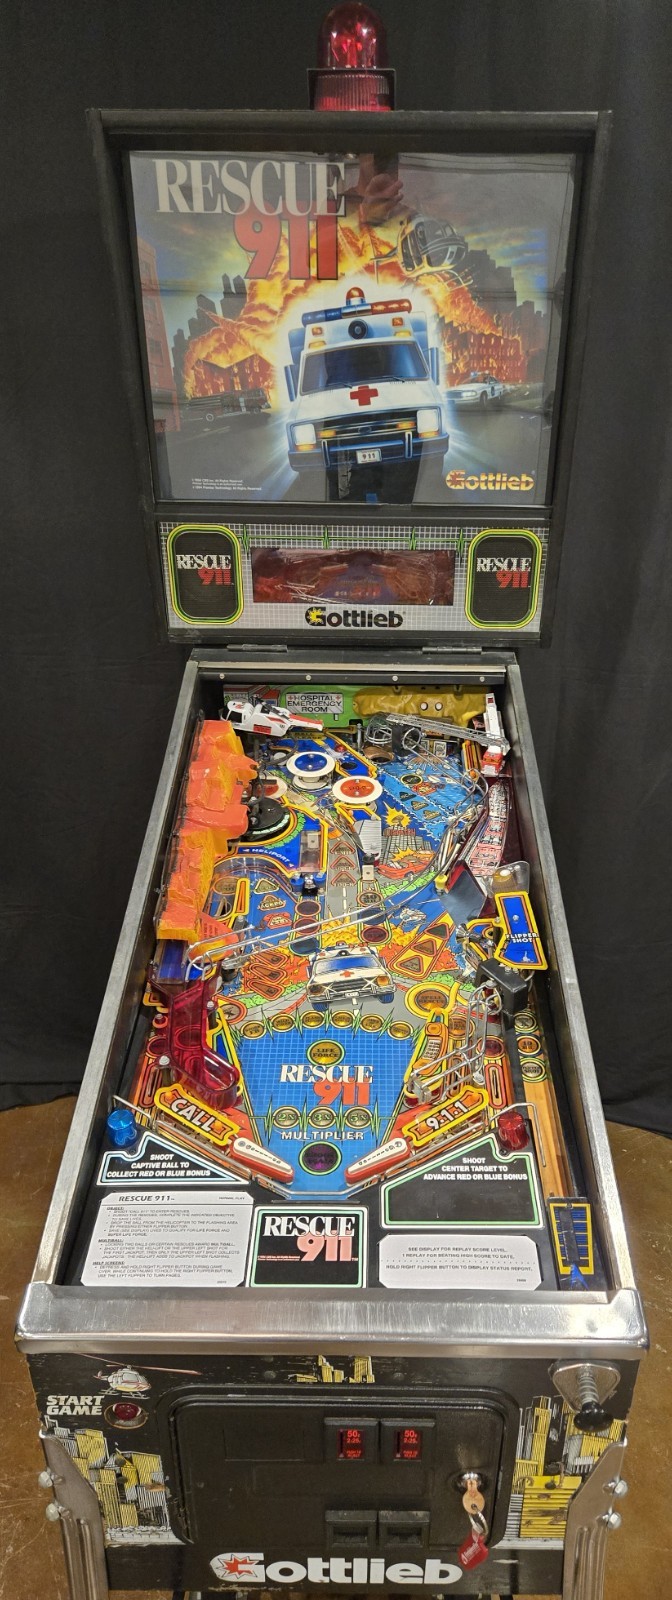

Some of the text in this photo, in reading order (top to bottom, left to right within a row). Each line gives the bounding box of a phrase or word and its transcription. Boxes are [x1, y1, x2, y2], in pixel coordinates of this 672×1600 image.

[152, 159, 346, 217] RESCUE
[233, 205, 338, 280] 911
[445, 469, 534, 491] Gottlieb
[175, 554, 232, 570] RESCUE
[476, 557, 532, 572] RESCUE
[197, 568, 231, 586] 911
[496, 570, 529, 588] 911
[305, 606, 403, 628] Gottlieb
[252, 848, 290, 862] HELIPORT
[279, 1064, 374, 1084] RESCUE
[313, 1080, 370, 1106] 911
[170, 1098, 216, 1132] CALL
[281, 1131, 364, 1140] MULTIPLIER
[106, 1170, 138, 1178] COLLECT
[166, 1169, 186, 1177] BLUE
[186, 1169, 211, 1177] BONUS
[179, 1161, 190, 1169] TO
[262, 1216, 355, 1237] RESCUE
[296, 1234, 352, 1262] 911
[46, 1395, 105, 1406] START
[46, 1405, 103, 1416] GAME
[209, 1552, 463, 1584] Gottlieb
